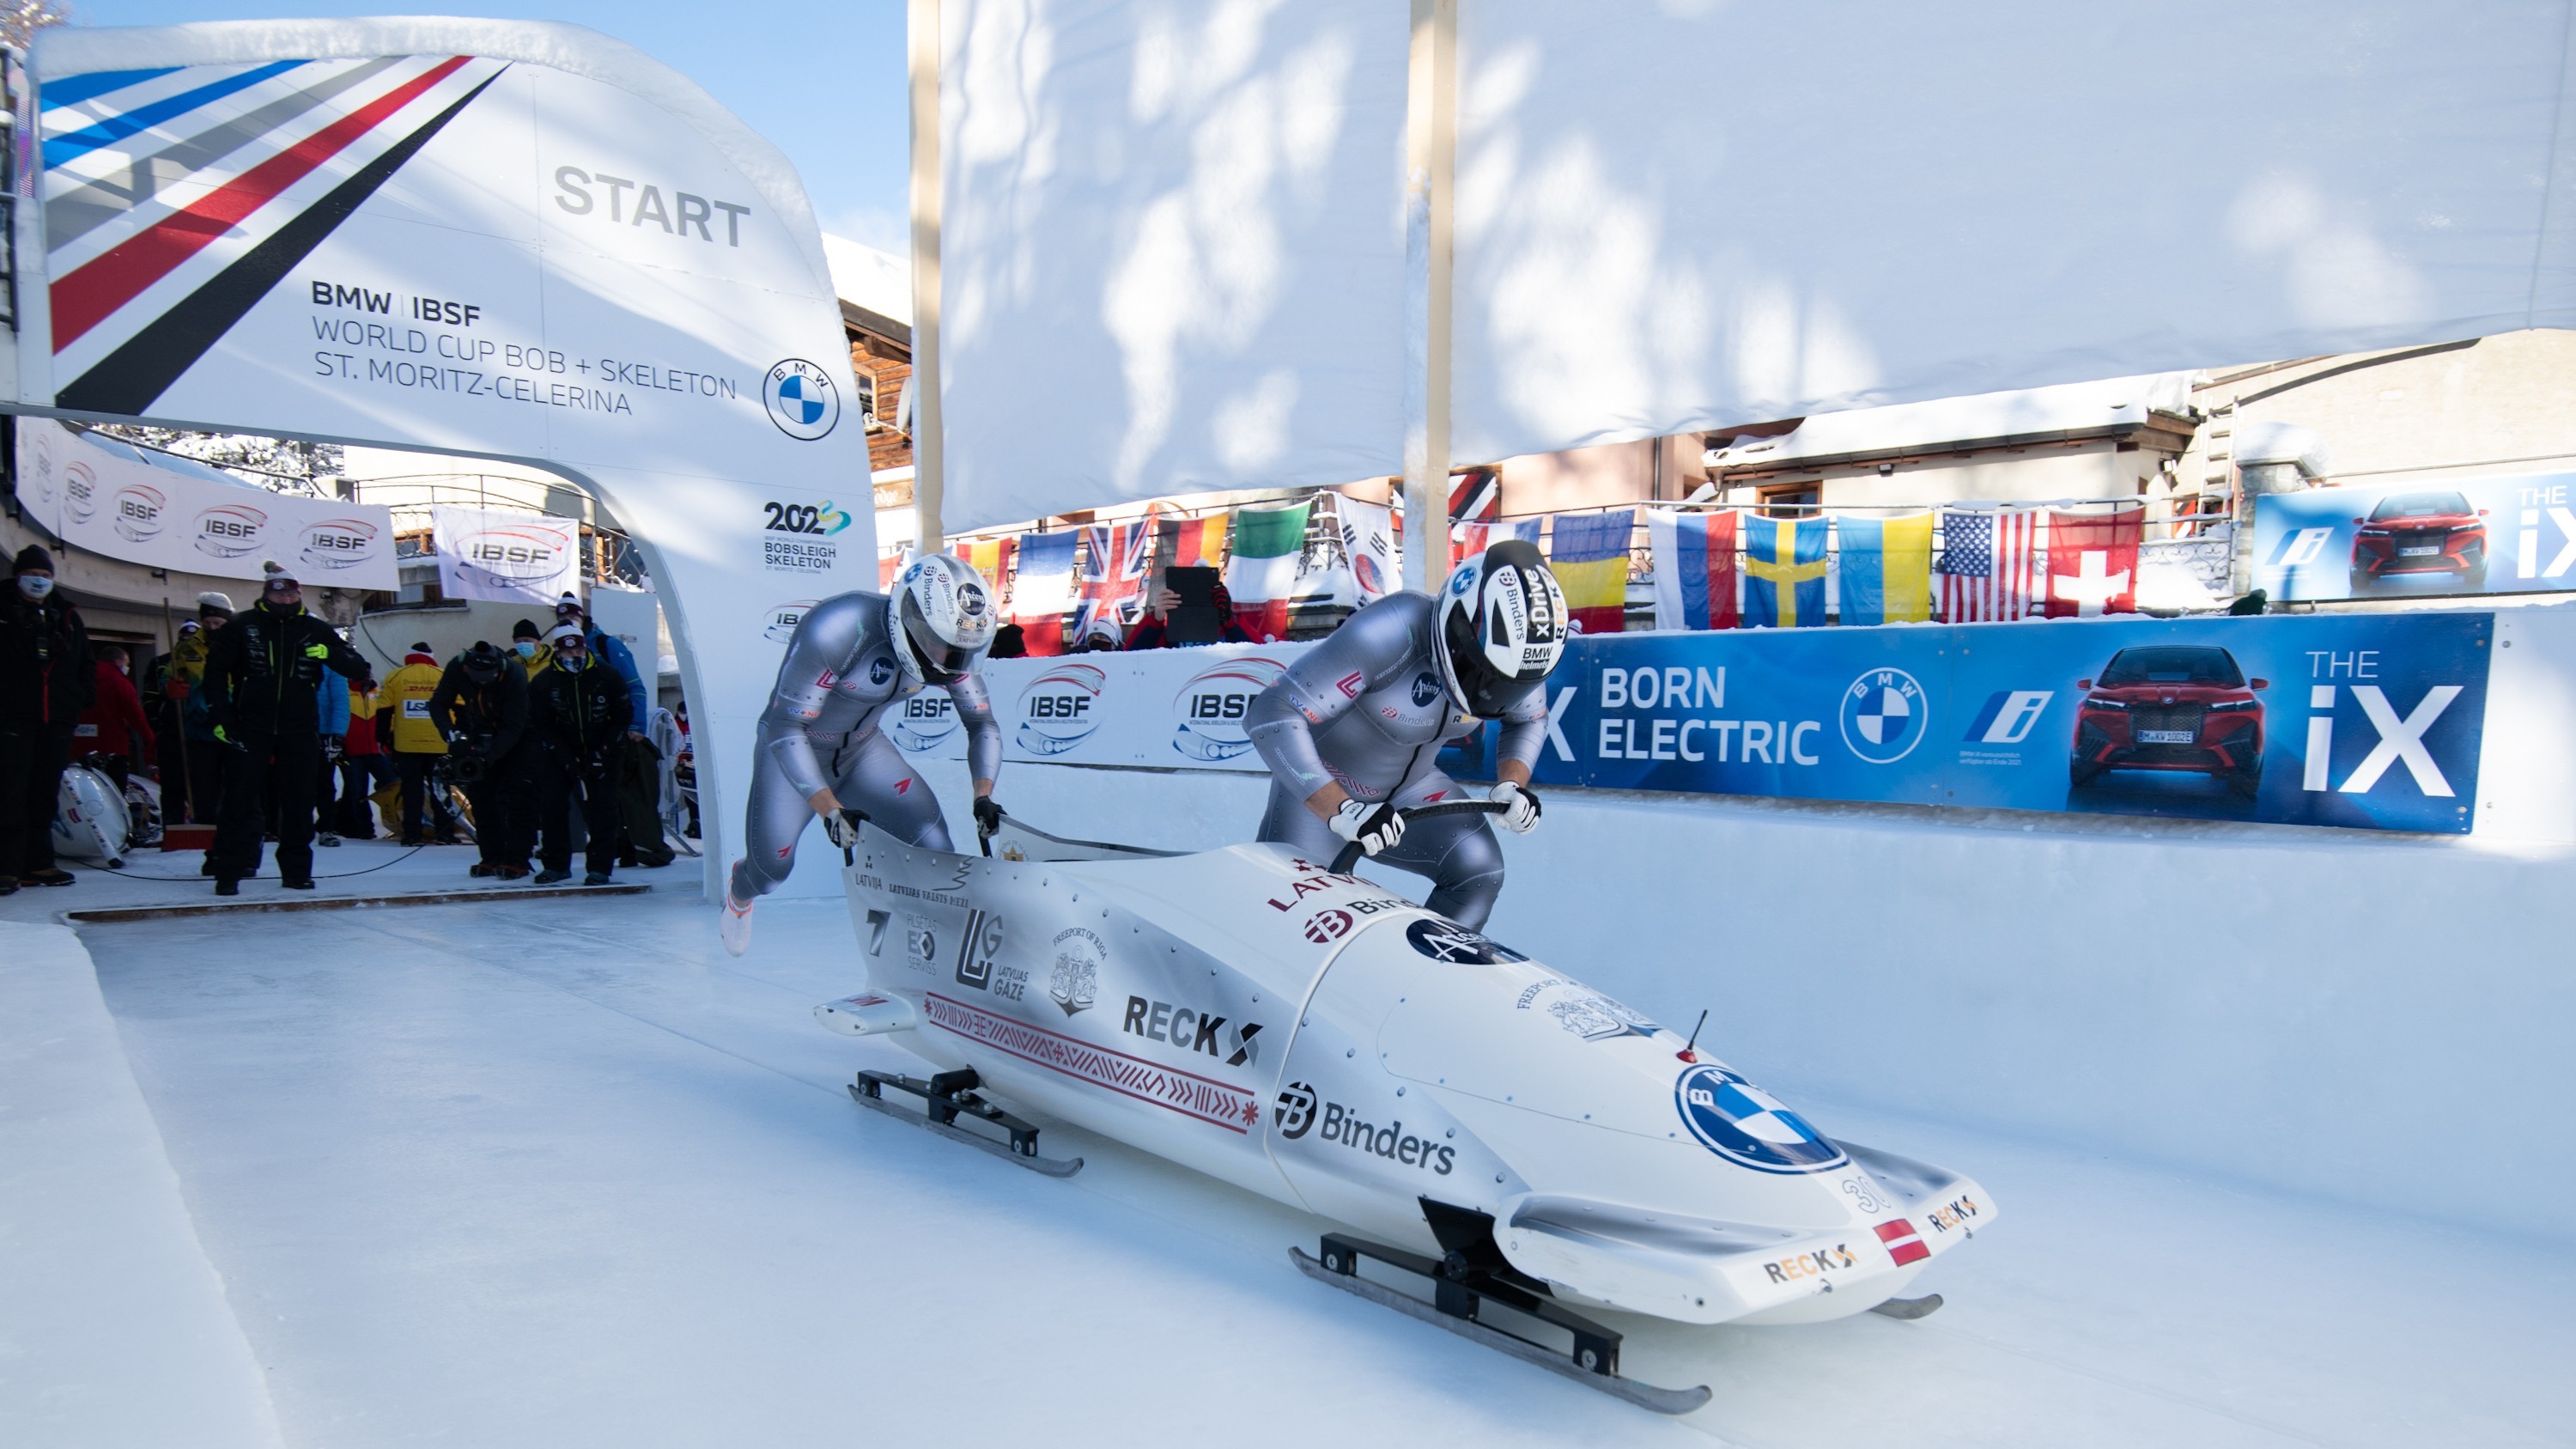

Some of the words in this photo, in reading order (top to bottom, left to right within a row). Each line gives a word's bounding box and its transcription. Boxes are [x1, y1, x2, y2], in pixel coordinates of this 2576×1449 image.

[554, 166, 751, 247] START
[311, 280, 392, 314] BMW
[412, 295, 481, 327] IBSF
[312, 314, 428, 354] WORLD
[437, 333, 495, 362] CUP
[505, 344, 566, 374] BOB
[600, 359, 737, 399] SKELETON
[314, 350, 358, 380] ST.
[369, 357, 632, 416] MORITZ-CELERINA
[2516, 484, 2567, 507] THE
[120, 499, 158, 521] IBSF
[205, 519, 257, 538] IBSF
[312, 533, 367, 550] IBSF
[472, 543, 551, 563] IBSF
[764, 542, 837, 558] BOBSLEIGH
[765, 553, 831, 569] SKELETON
[923, 577, 933, 617] Binders
[1524, 569, 1551, 638] xDrive
[1506, 588, 1526, 642] Binders
[1519, 659, 1549, 671] helmets
[1522, 646, 1553, 660] BMW
[2304, 650, 2381, 679] THE
[1601, 666, 1726, 709] BORN
[1852, 672, 1918, 700] BMW
[903, 698, 952, 718] IBSF
[1030, 695, 1091, 718] IBSF
[1397, 713, 1435, 727] Binders
[1598, 718, 1821, 766] ELECTRIC
[2302, 685, 2465, 798] iX
[855, 873, 883, 891] LATVIJA
[889, 883, 920, 898] LATVIJAS
[921, 889, 948, 904] VALSTS
[1053, 927, 1087, 947] FREEPORT
[1085, 930, 1096, 941] OF
[1094, 937, 1108, 961] RIGA
[908, 955, 937, 976] SERVISS
[998, 965, 1030, 983] LATVIJAS
[993, 977, 1025, 1002] GĀZE
[1517, 978, 1562, 1010] FREEPORT
[1320, 1101, 1457, 1177] Binders
